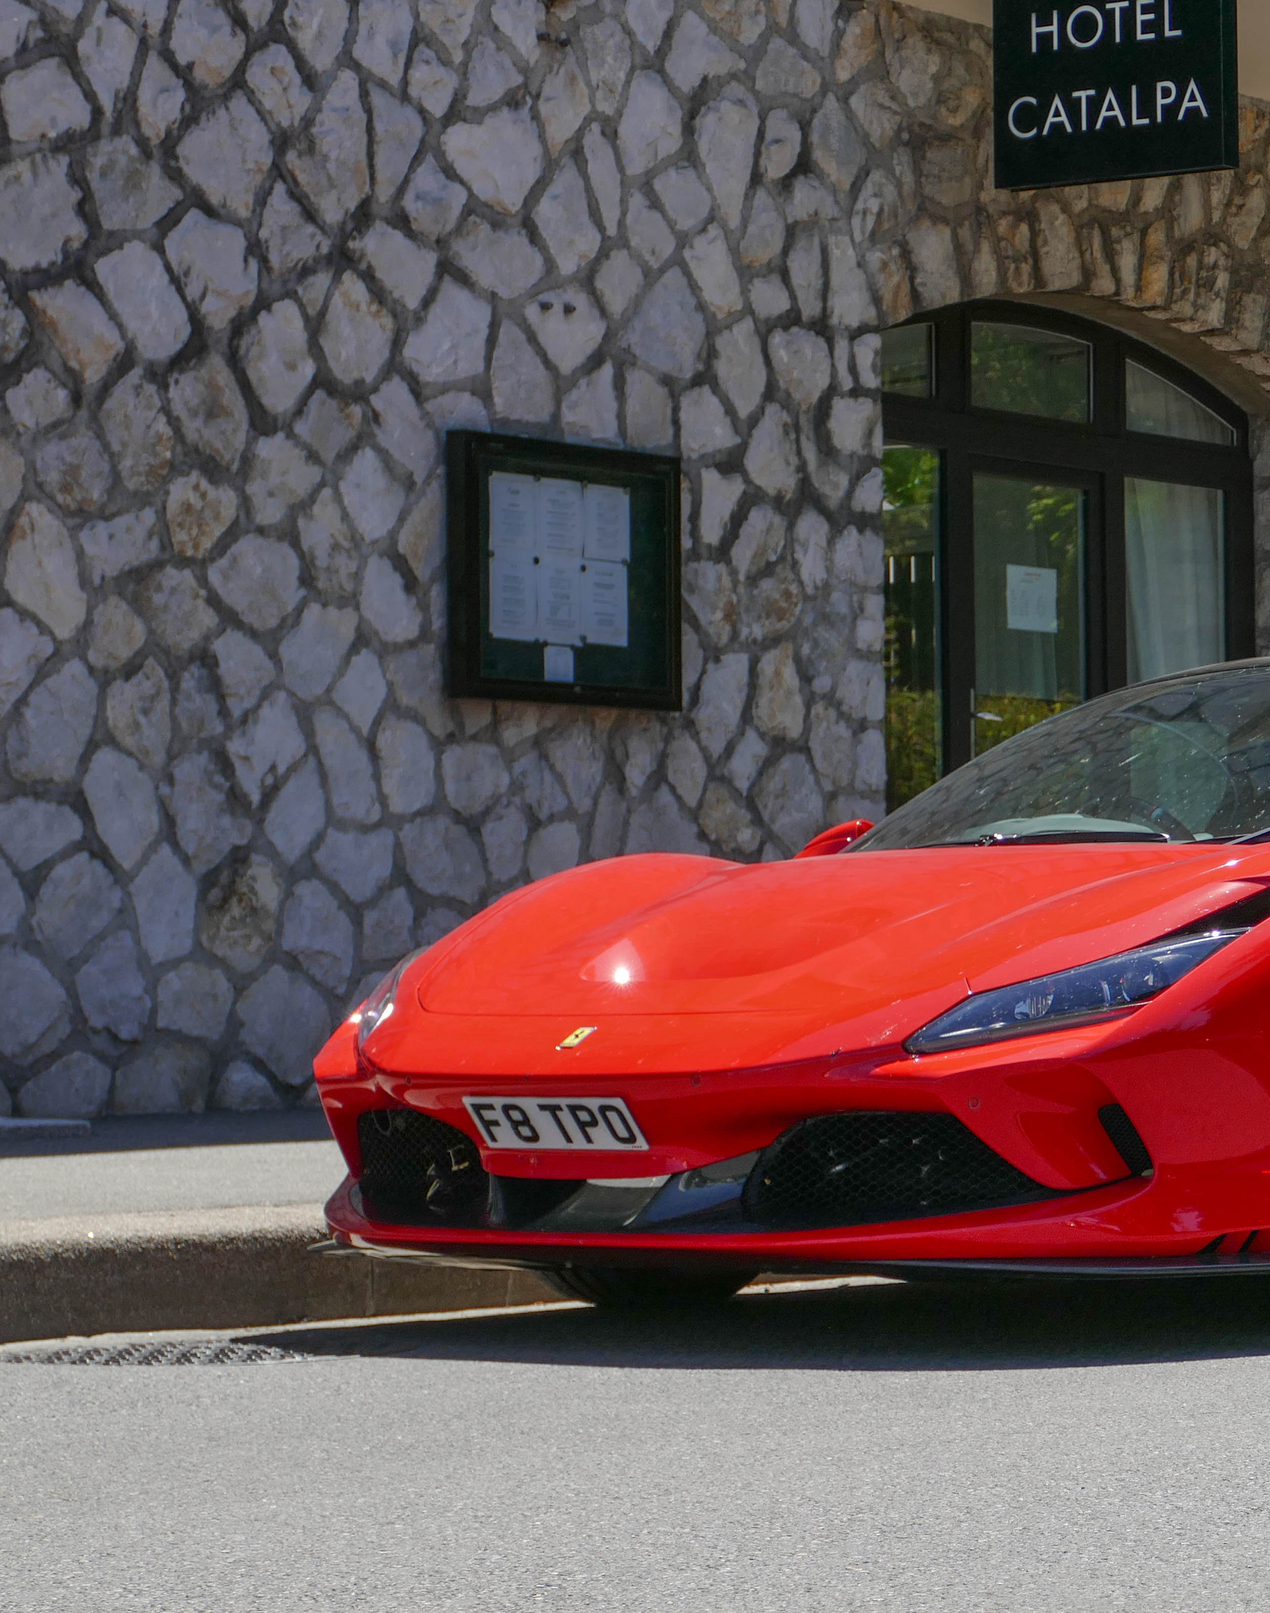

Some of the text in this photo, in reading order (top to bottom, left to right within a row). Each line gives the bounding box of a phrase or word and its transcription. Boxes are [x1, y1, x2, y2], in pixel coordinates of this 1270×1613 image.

[1030, 0, 1182, 53] HOTEL
[1008, 78, 1208, 138] CATALPA
[470, 1103, 540, 1143] F8
